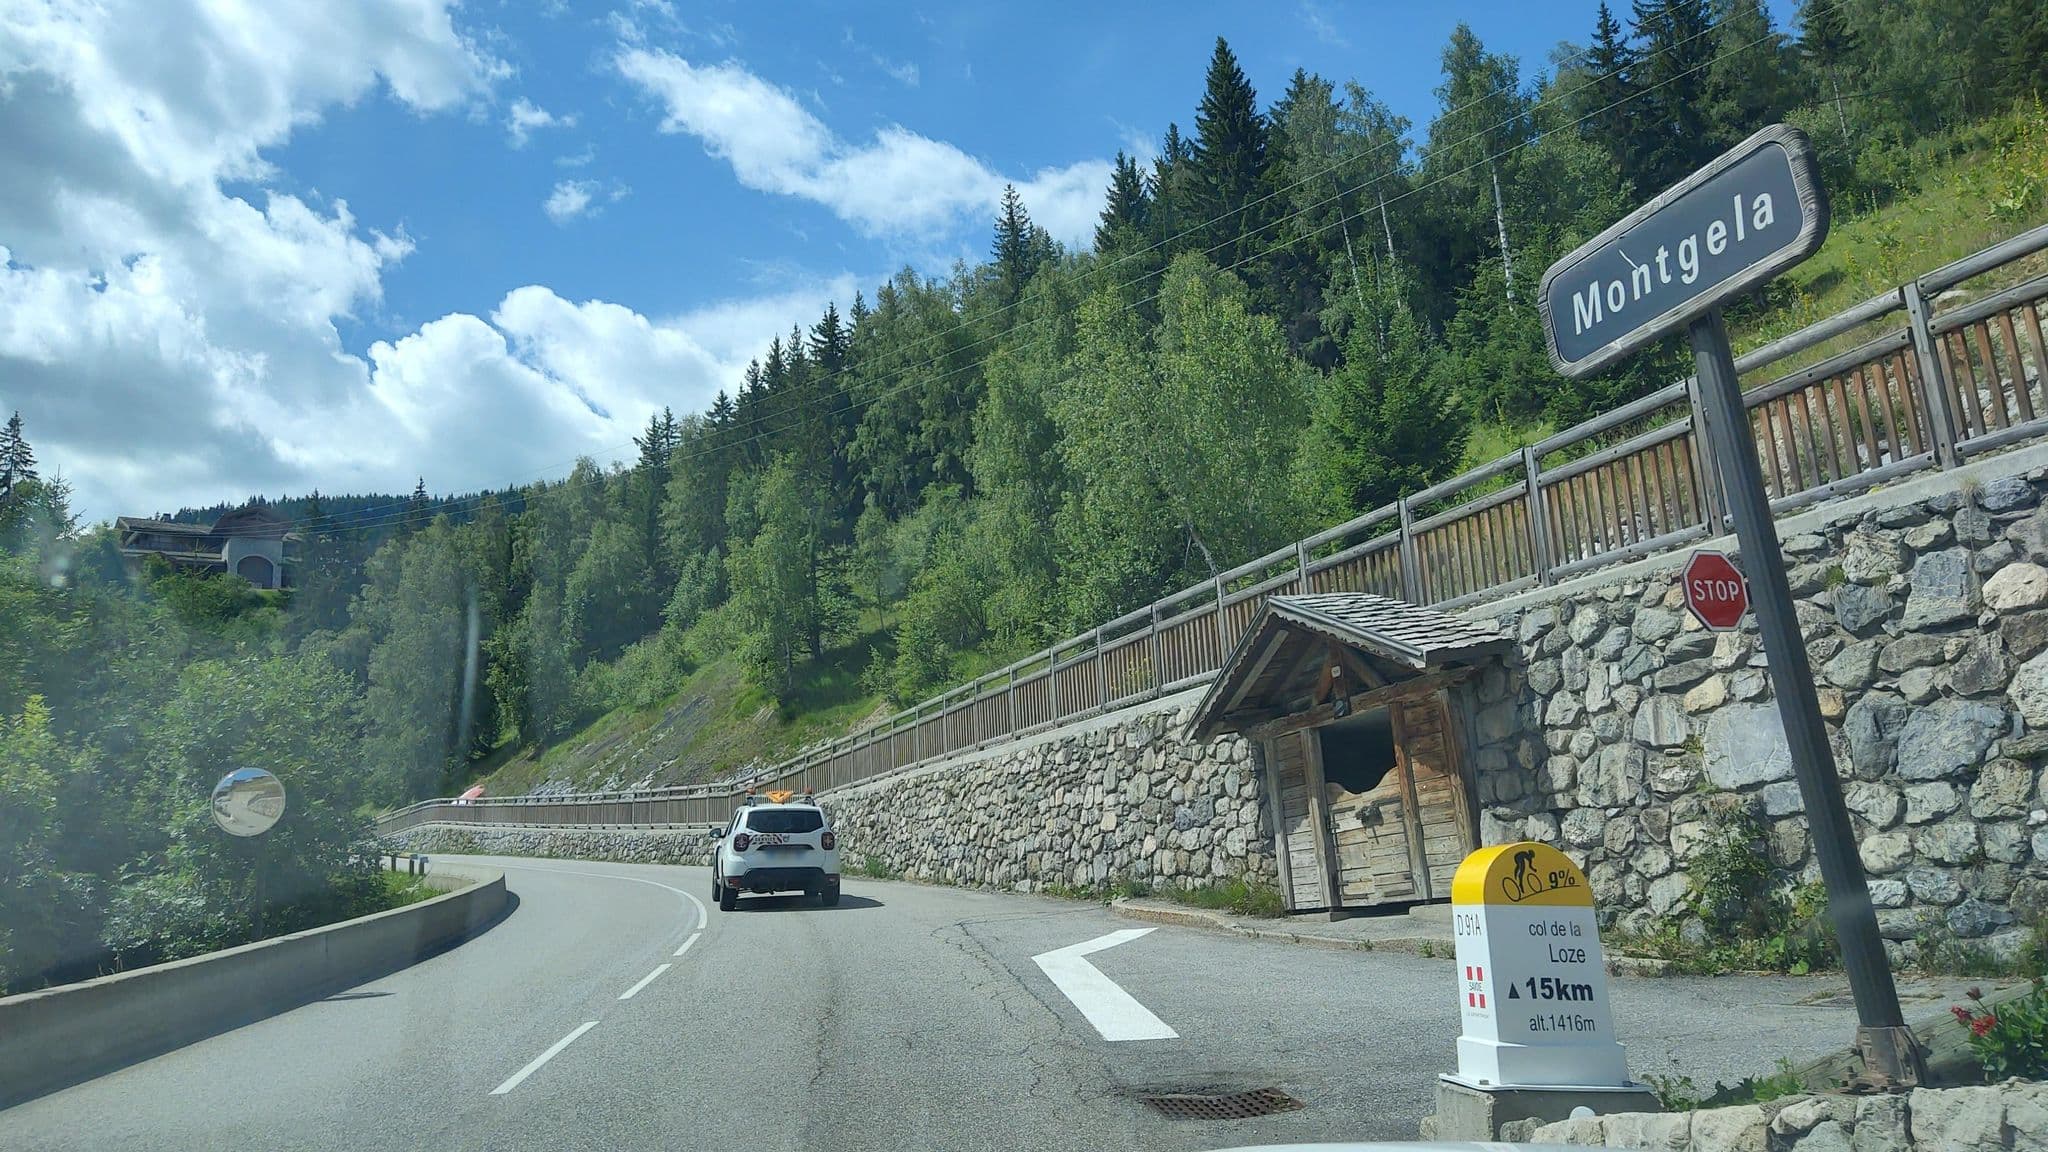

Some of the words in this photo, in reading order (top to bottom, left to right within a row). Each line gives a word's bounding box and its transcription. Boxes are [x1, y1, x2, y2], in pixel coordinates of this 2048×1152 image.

[1571, 192, 1775, 336] Montgela
[1693, 579, 1740, 601] STOP
[1548, 868, 1576, 889] 9%
[1457, 914, 1464, 936] D
[1528, 920, 1547, 937] col
[1550, 920, 1567, 937] de
[1569, 920, 1582, 937] la
[1548, 943, 1586, 963] Loze
[1525, 976, 1594, 1001] 15km
[1528, 1014, 1596, 1032] alt.1416m
